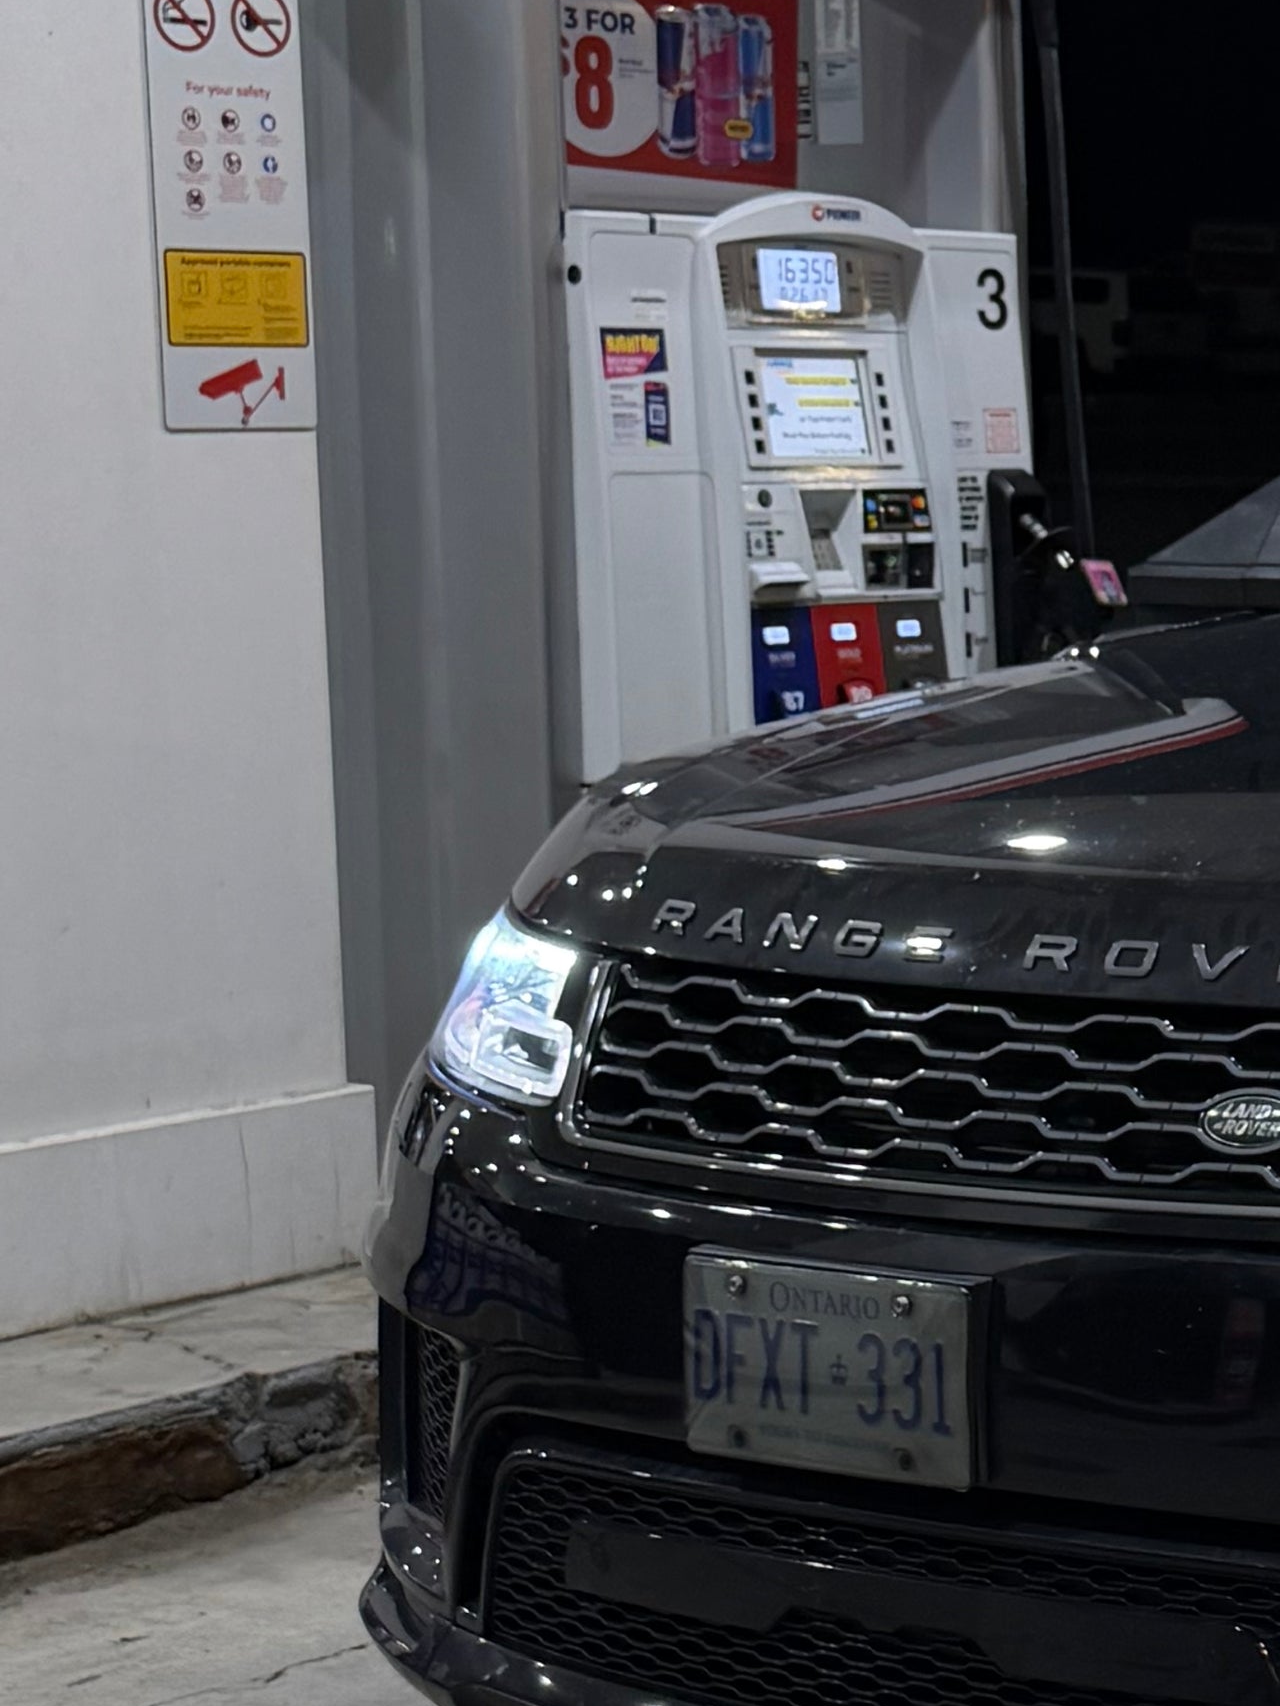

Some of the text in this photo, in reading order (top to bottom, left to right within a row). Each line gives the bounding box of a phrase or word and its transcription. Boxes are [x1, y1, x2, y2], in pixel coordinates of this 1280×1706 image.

[564, 7, 635, 35] 3 FOR
[977, 268, 1008, 330] 3
[651, 898, 955, 962] RANGE
[1222, 1103, 1273, 1120] LAND
[769, 1281, 880, 1320] ONTARIO
[693, 1308, 951, 1435] DFXT 331
